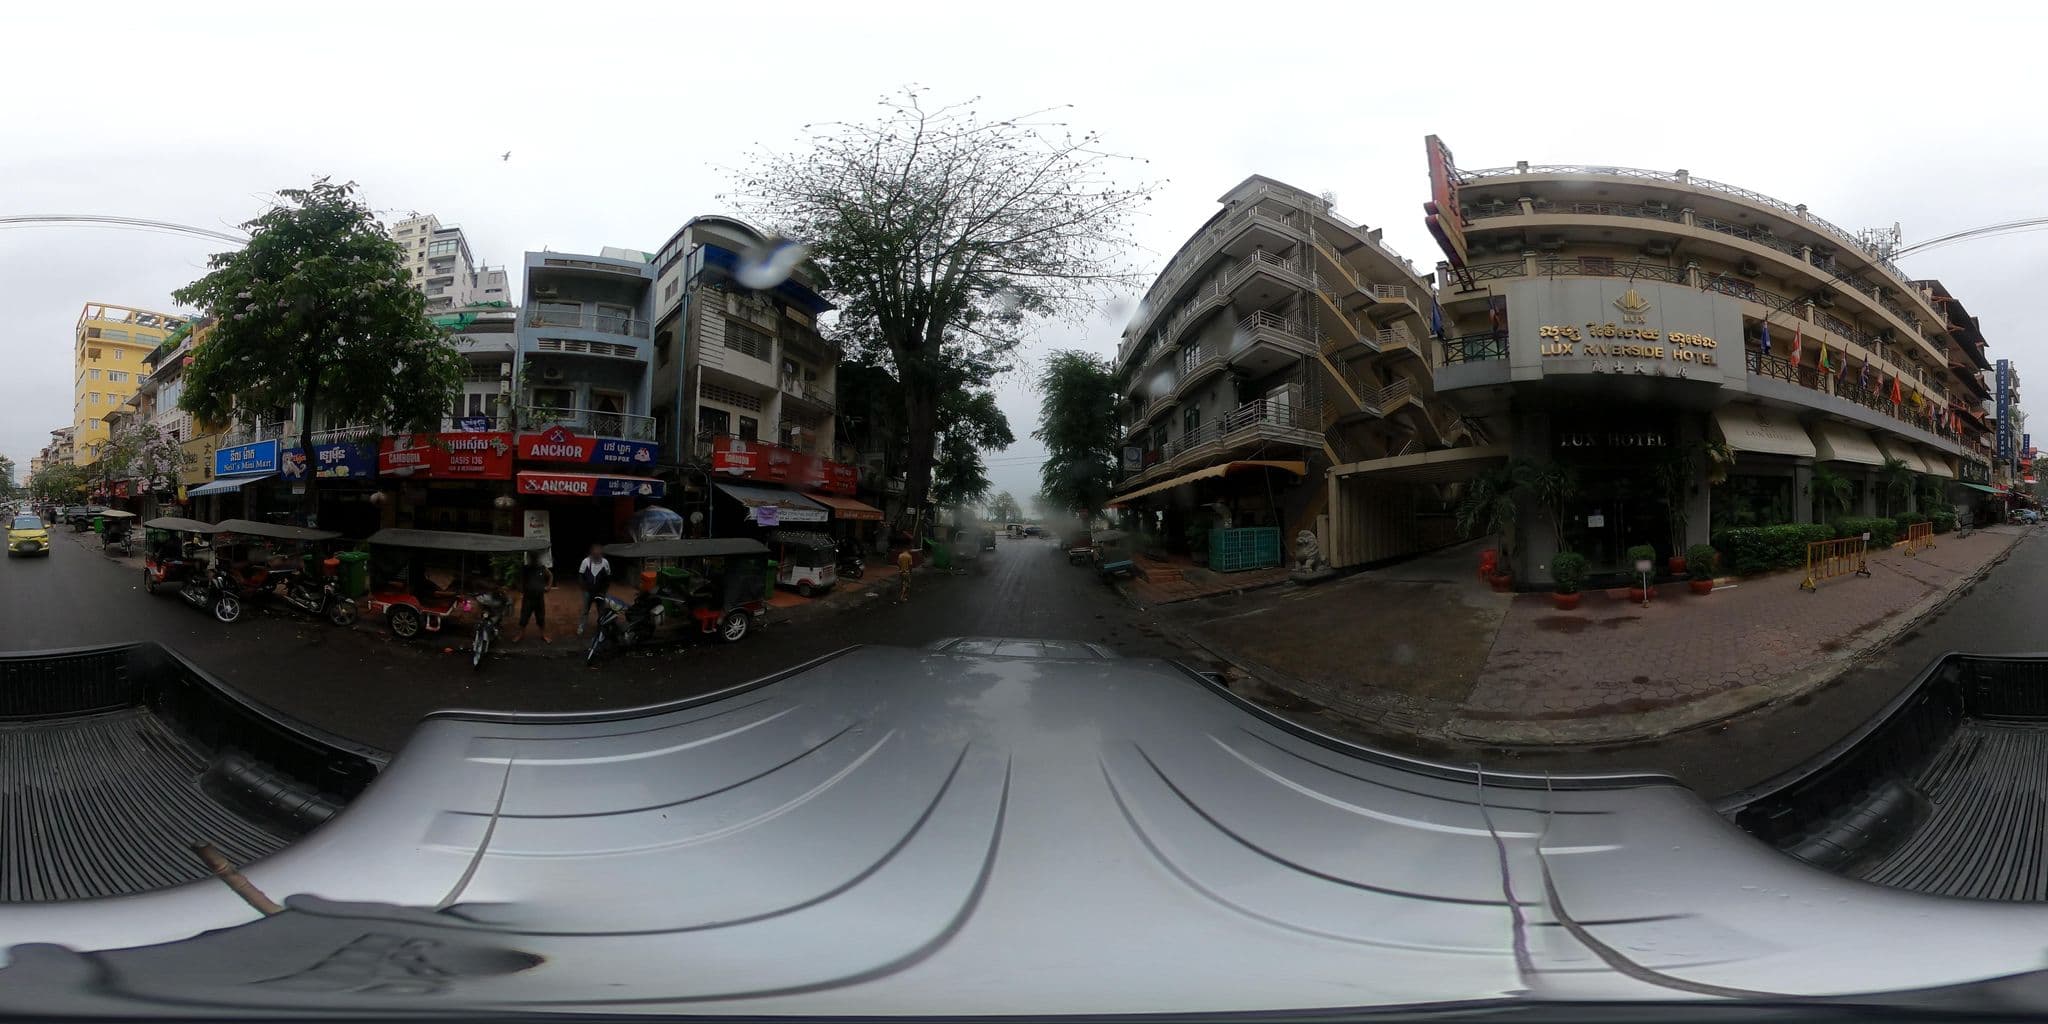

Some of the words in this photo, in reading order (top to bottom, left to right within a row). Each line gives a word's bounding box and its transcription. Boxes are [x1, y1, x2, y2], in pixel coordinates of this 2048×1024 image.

[1541, 343, 1574, 356] LUX
[1584, 344, 1665, 359] RIVERSIDE
[1673, 349, 1719, 367] HOTEL
[1560, 431, 1600, 448] LUX
[1608, 431, 1668, 448] HOTEL
[530, 443, 583, 458] ANCHOR
[541, 479, 588, 493] ANCHOR
